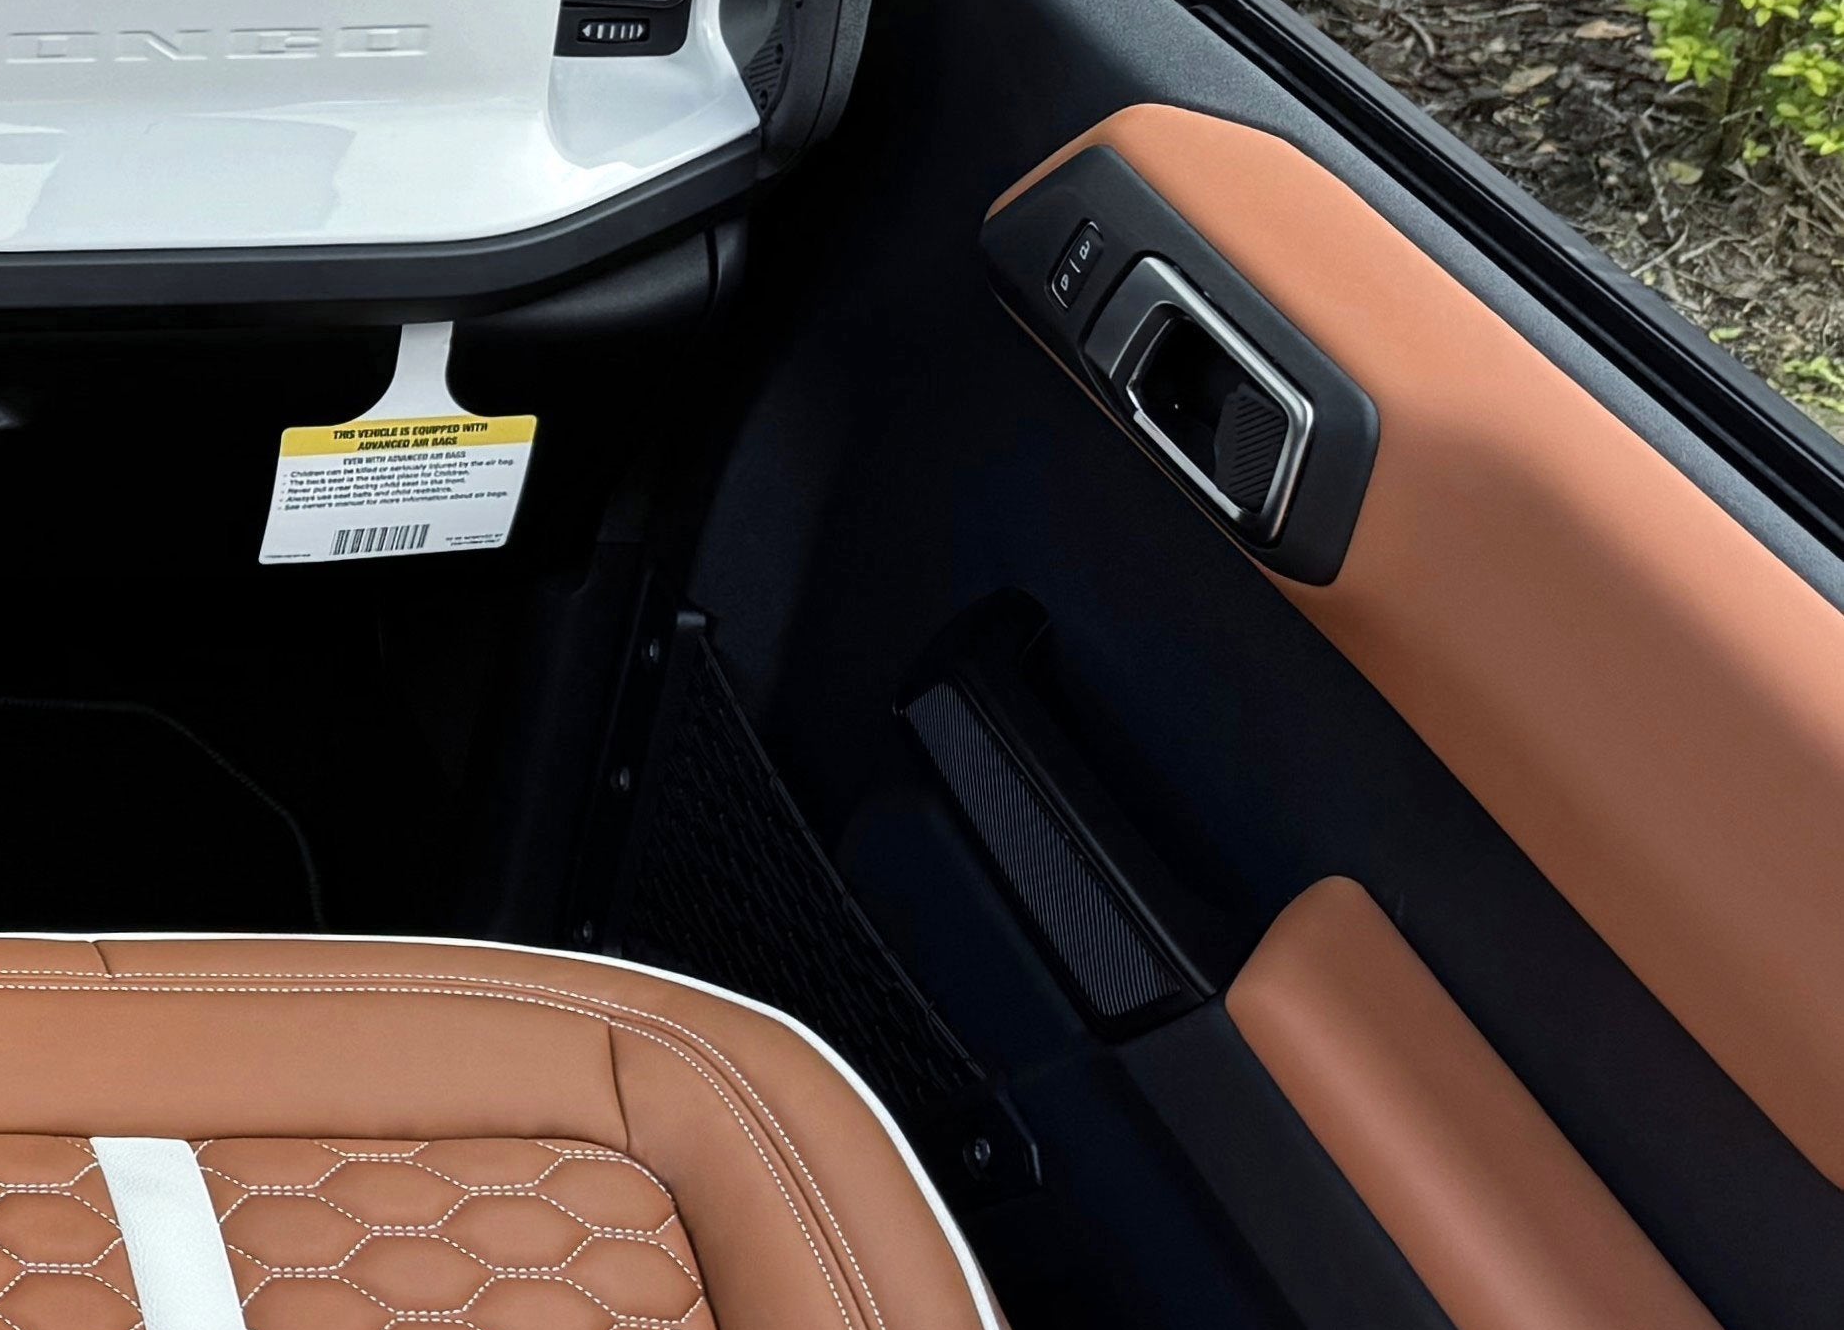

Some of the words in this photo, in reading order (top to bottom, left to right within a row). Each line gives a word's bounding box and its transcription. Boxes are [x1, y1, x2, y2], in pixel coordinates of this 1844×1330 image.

[334, 430, 355, 439] THIS
[358, 427, 397, 438] VEHICLE
[400, 427, 409, 436] IS
[412, 424, 460, 436] EQUIPPED
[463, 423, 488, 432] WITH
[357, 440, 410, 451] ADVANCED
[412, 438, 429, 447] AIR
[432, 437, 458, 446] BAGS
[387, 453, 428, 462] ADVANCED
[291, 470, 325, 478] Children
